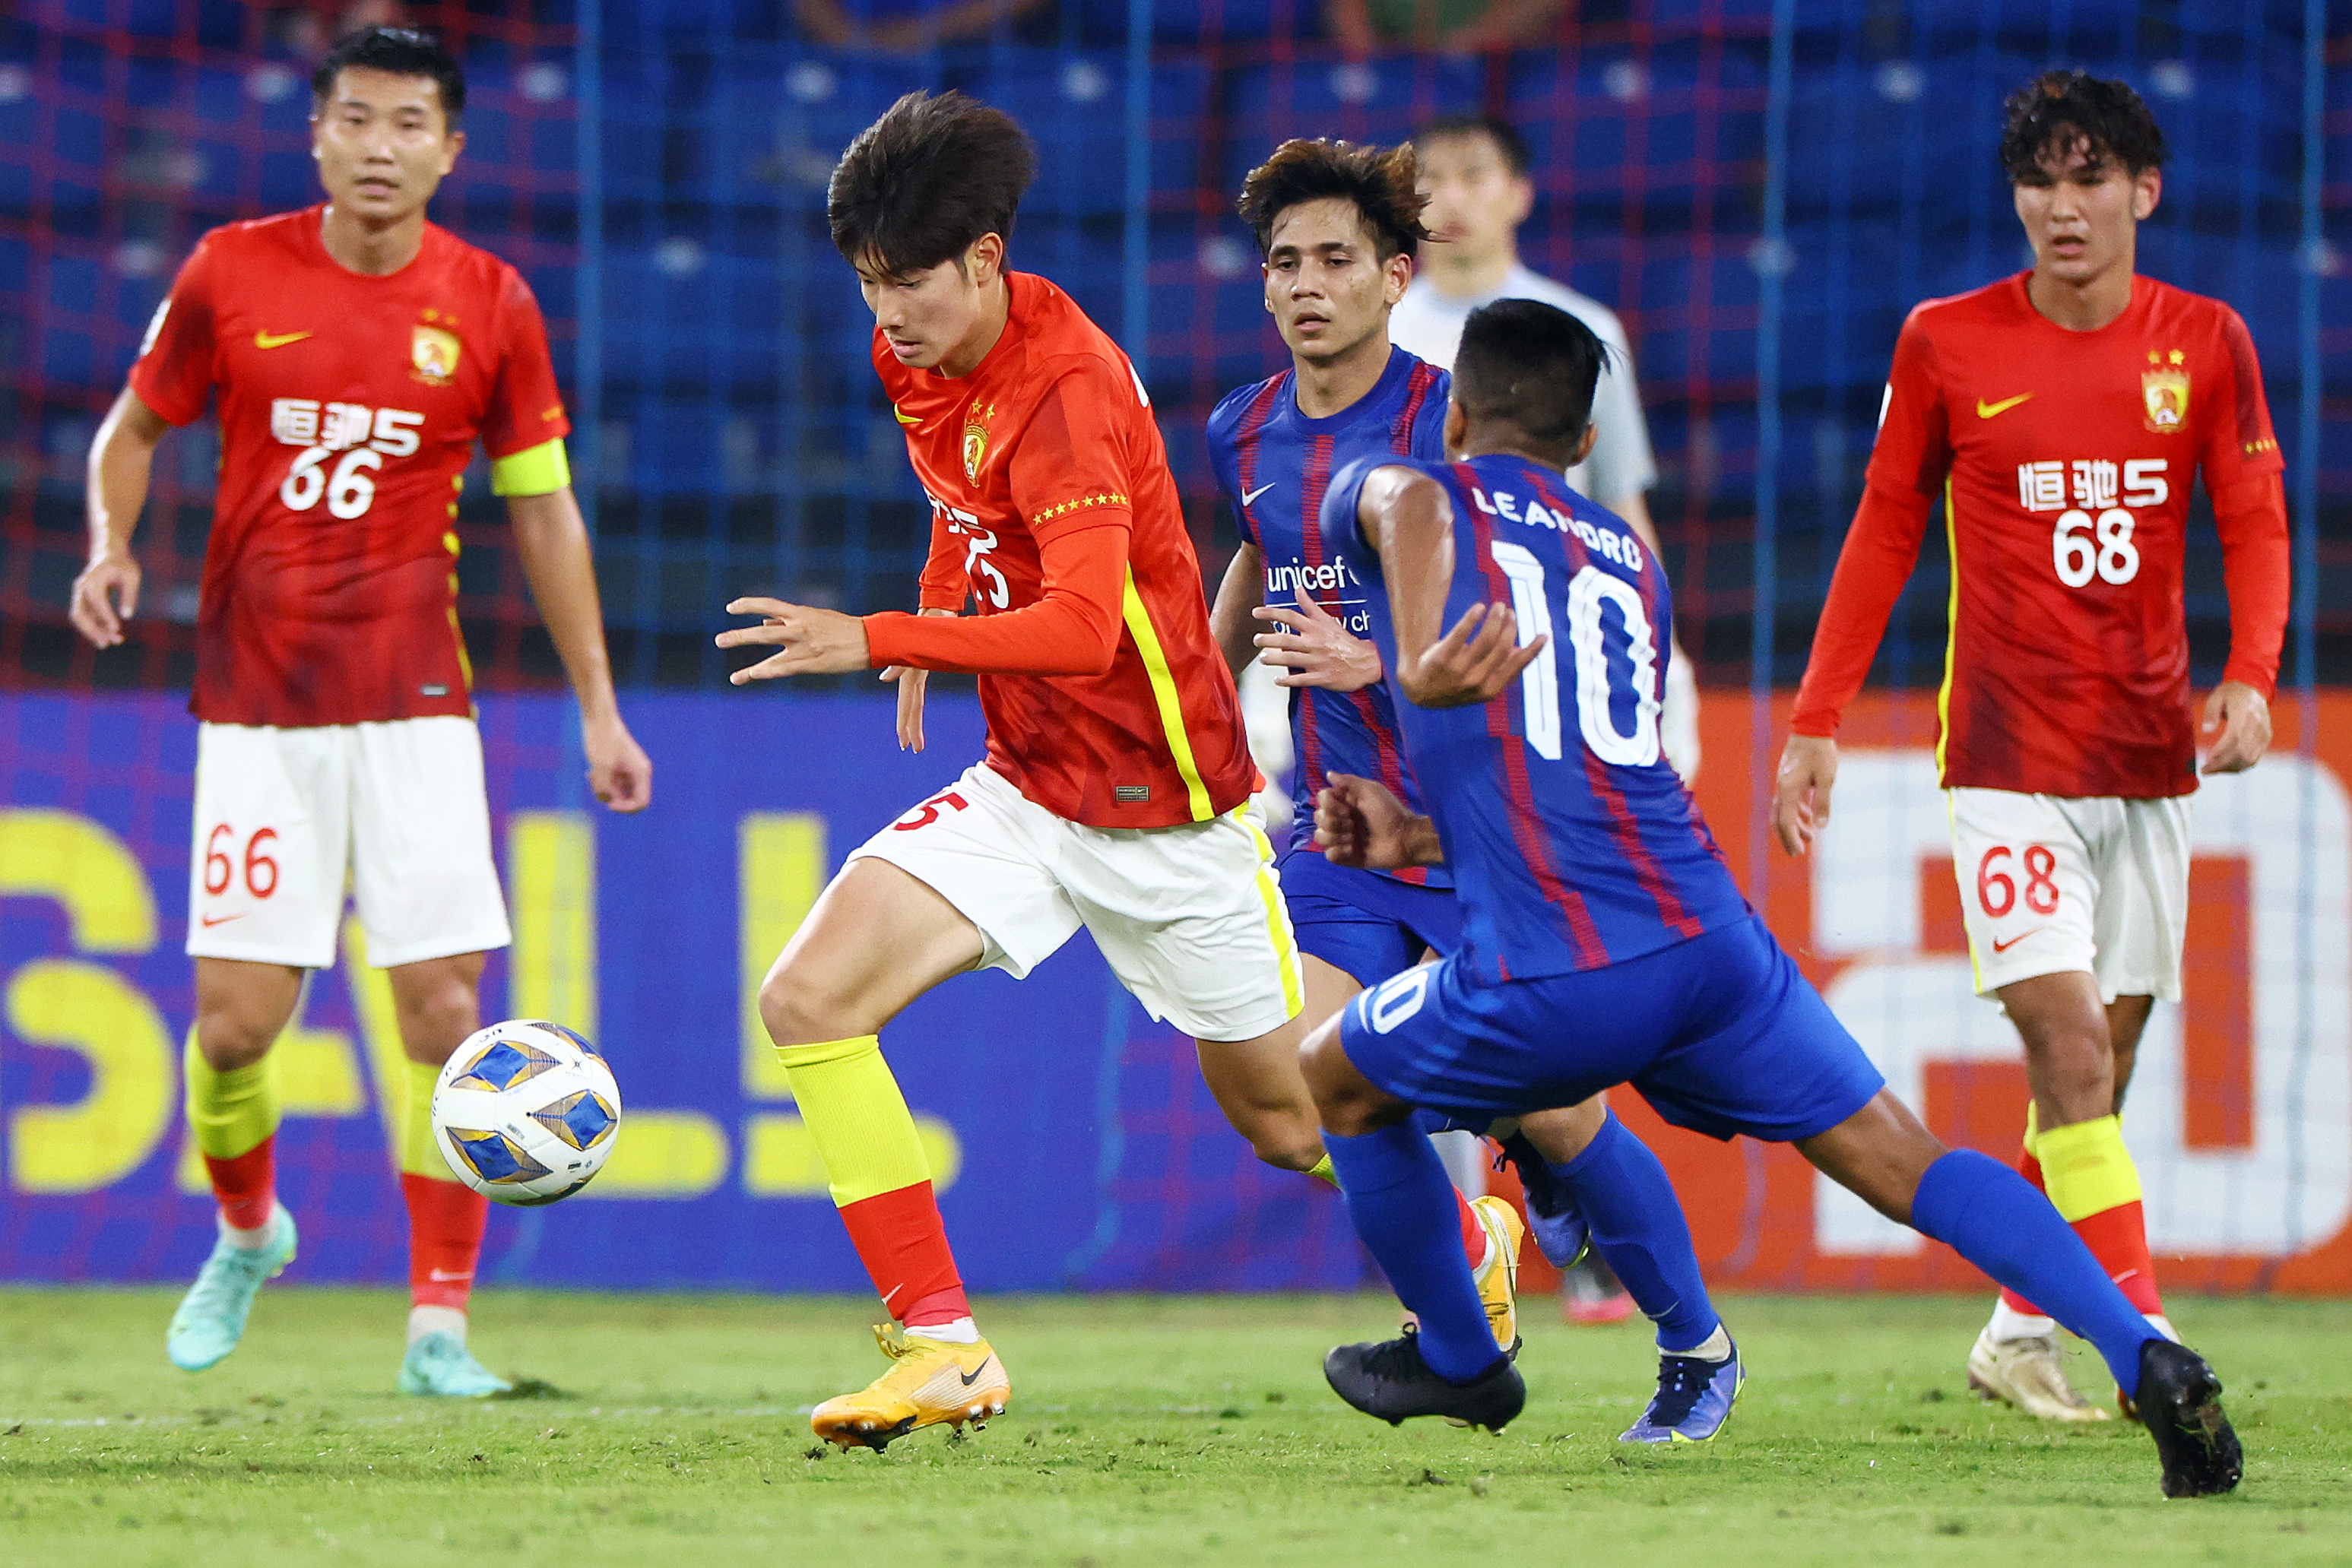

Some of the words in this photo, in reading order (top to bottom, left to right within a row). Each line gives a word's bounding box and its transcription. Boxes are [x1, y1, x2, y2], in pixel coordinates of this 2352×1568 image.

[280, 446, 382, 520] 66
[2018, 458, 2168, 512] 恒驰5
[1471, 486, 1644, 572] LEANDRO
[2052, 508, 2140, 588] 68
[1267, 555, 1346, 593] unicef
[1491, 540, 1663, 767] 10
[203, 823, 281, 901] 66
[1976, 845, 2060, 918] 68
